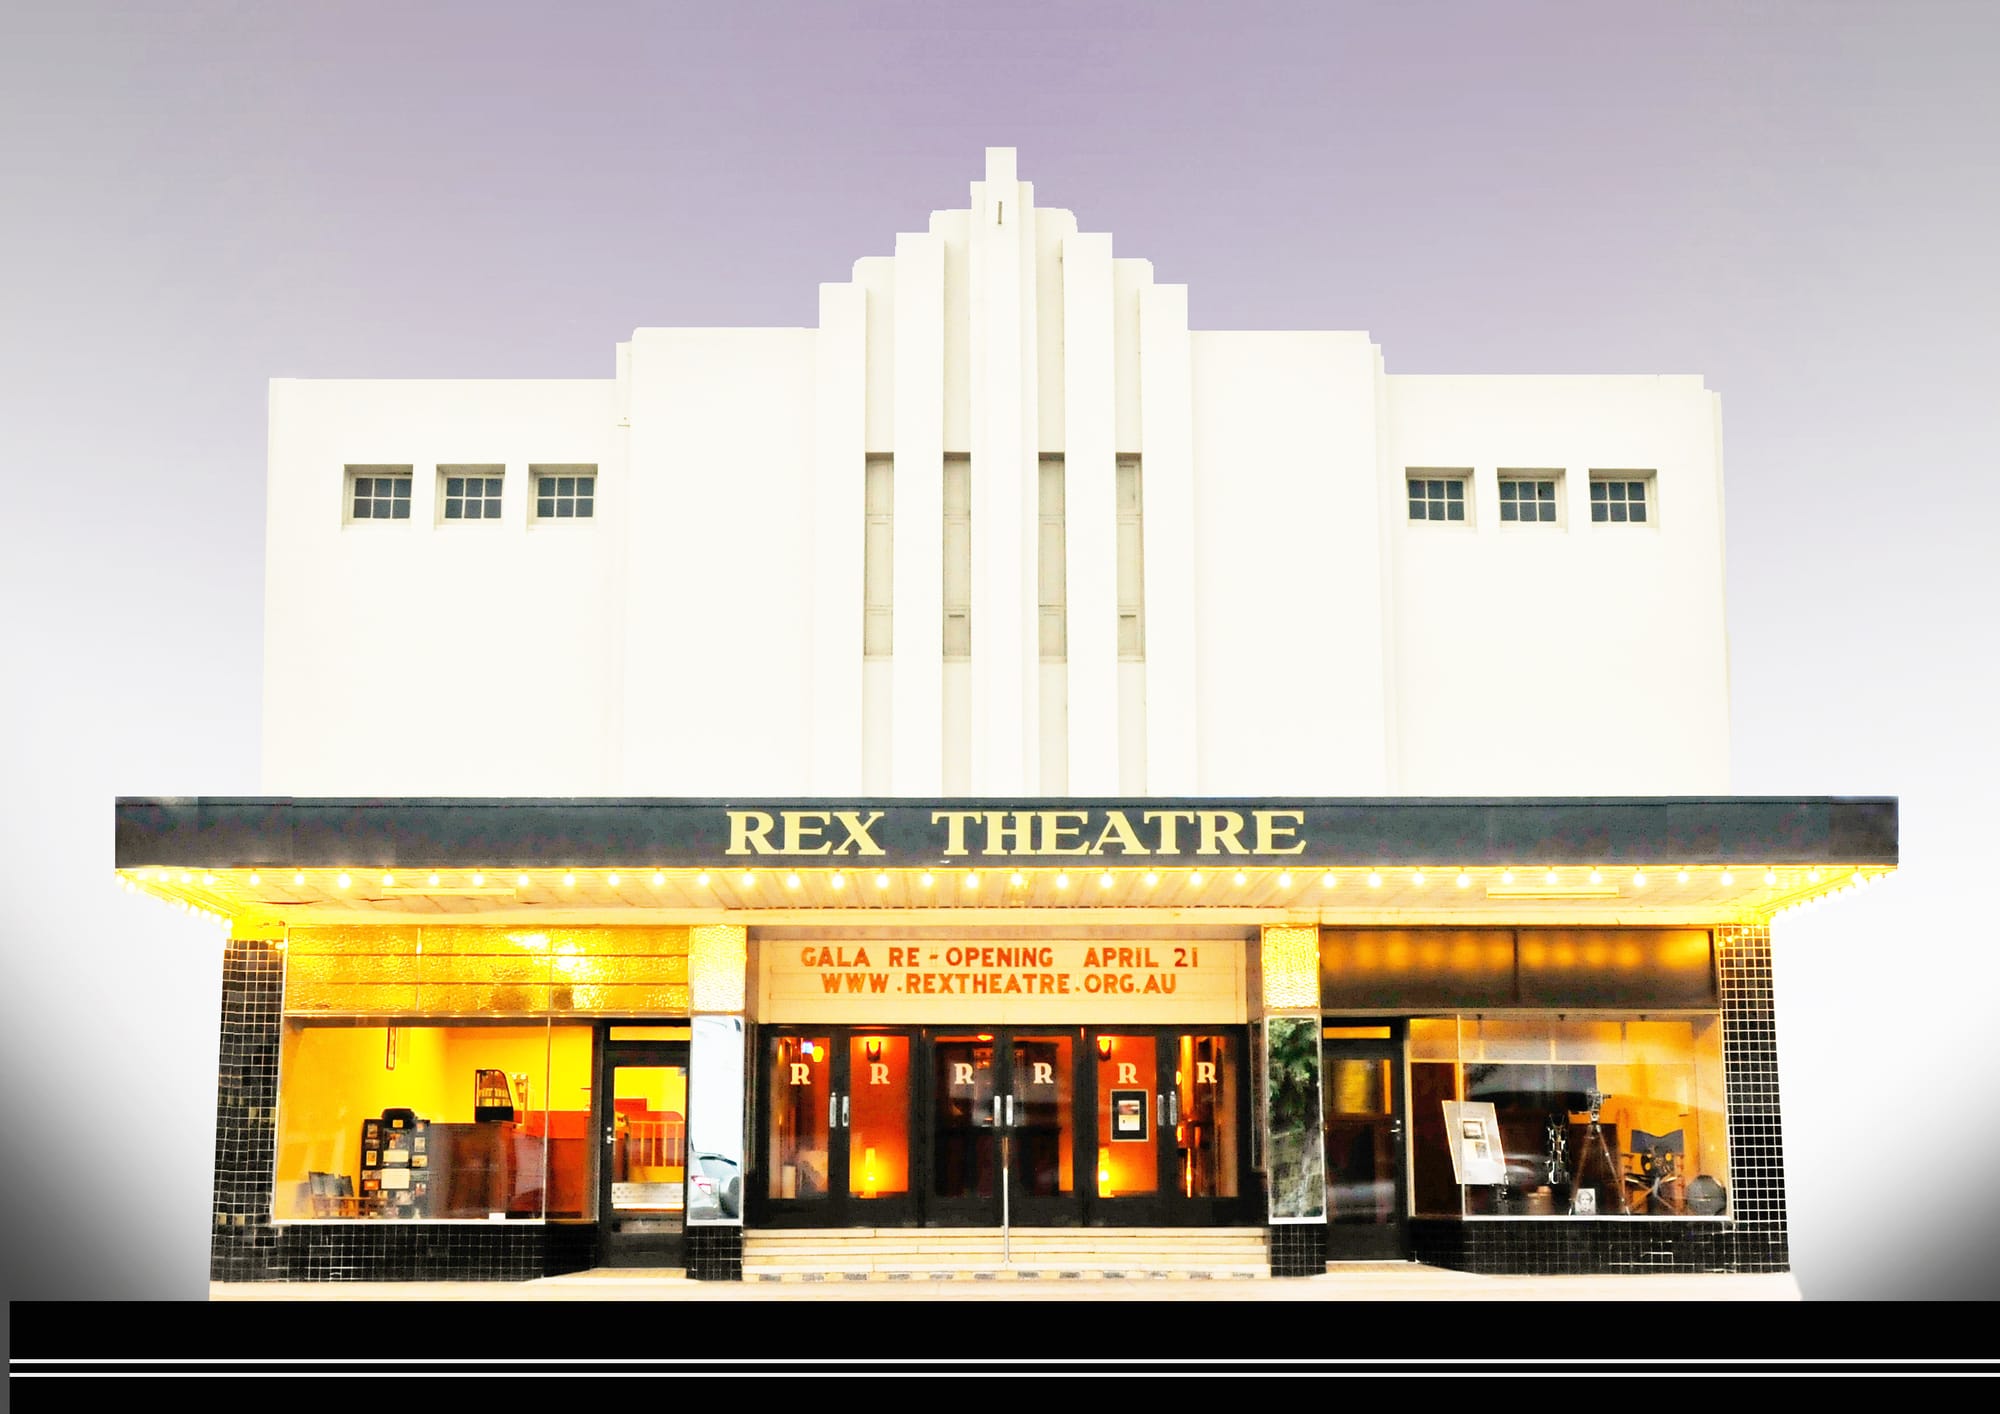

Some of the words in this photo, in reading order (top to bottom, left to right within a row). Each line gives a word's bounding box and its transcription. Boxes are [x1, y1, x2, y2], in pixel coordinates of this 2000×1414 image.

[725, 810, 886, 857] REX
[931, 809, 1308, 857] THEATRE
[801, 946, 871, 968] GALA
[1084, 946, 1159, 968] APRIL
[1174, 946, 1200, 968] 21
[790, 1062, 811, 1085] R
[869, 1062, 890, 1085] R
[953, 1062, 974, 1085] R
[1033, 1062, 1054, 1085] R
[1117, 1062, 1138, 1085] R
[1196, 1062, 1217, 1085] R
